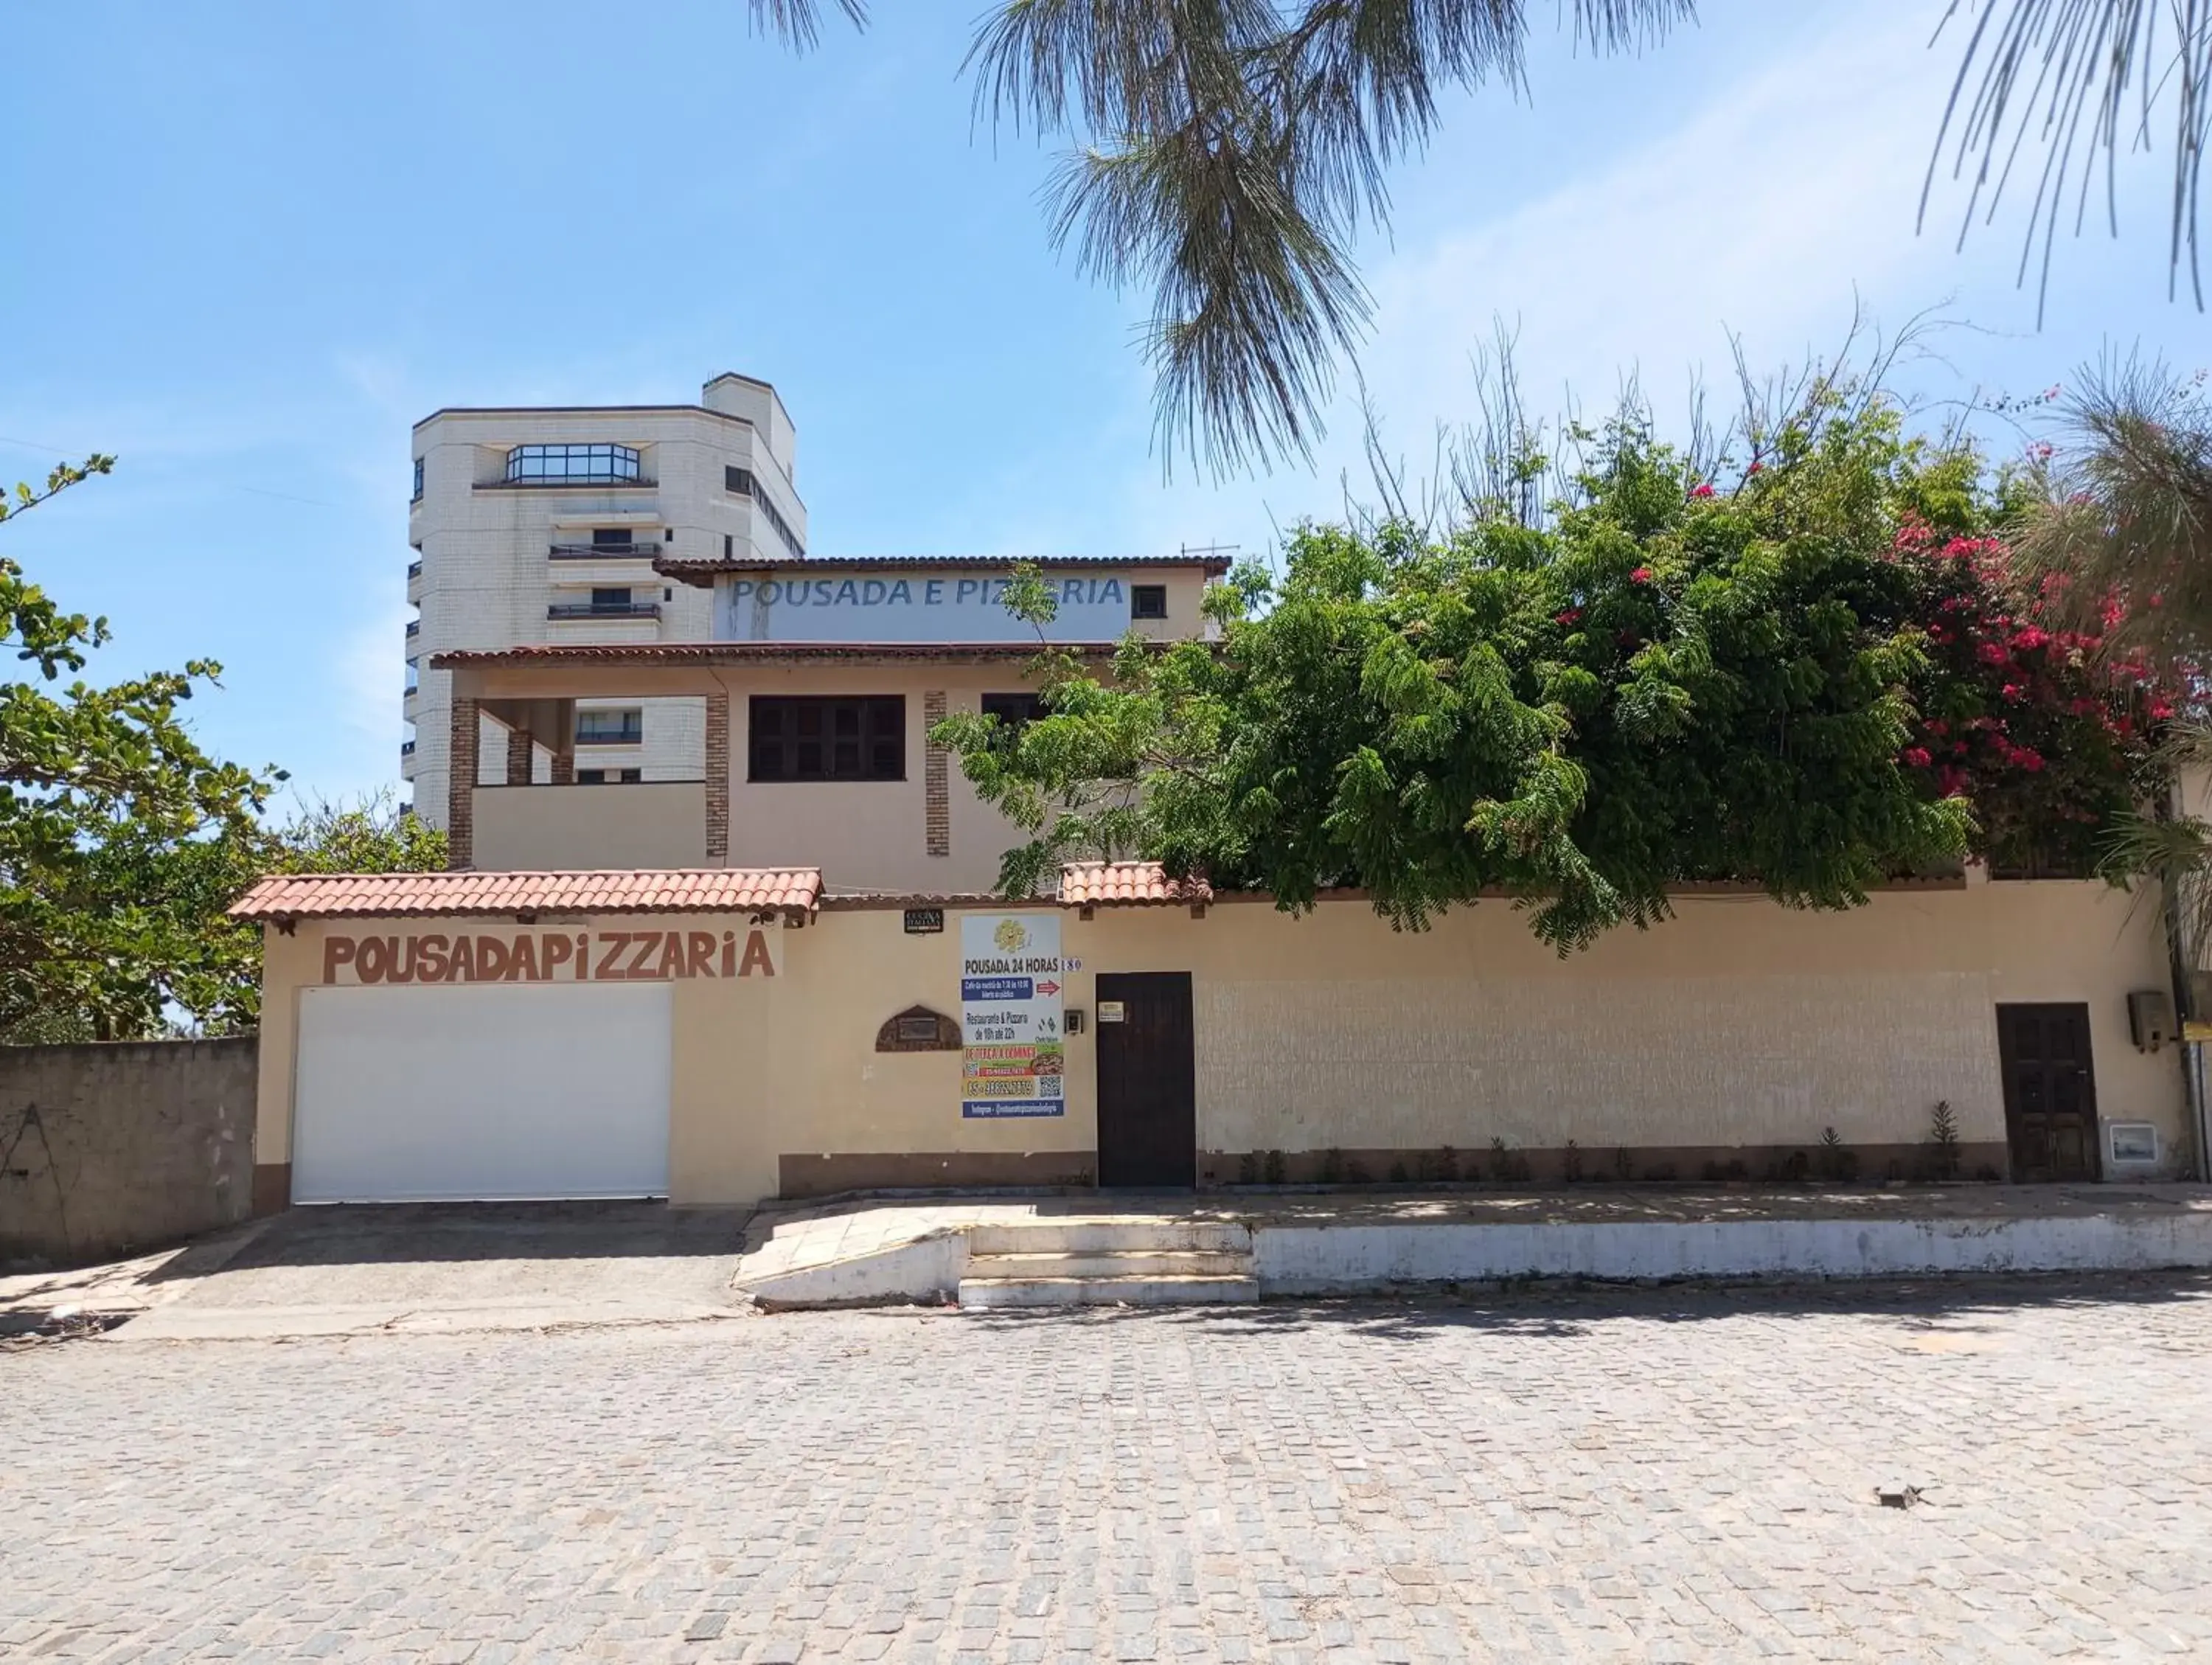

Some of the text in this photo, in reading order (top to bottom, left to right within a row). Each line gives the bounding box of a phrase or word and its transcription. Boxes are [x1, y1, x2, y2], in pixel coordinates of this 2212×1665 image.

[732, 578, 1124, 607] POUSADA E PIZRIA
[965, 958, 1058, 974] POUSADA 24 HORAS
